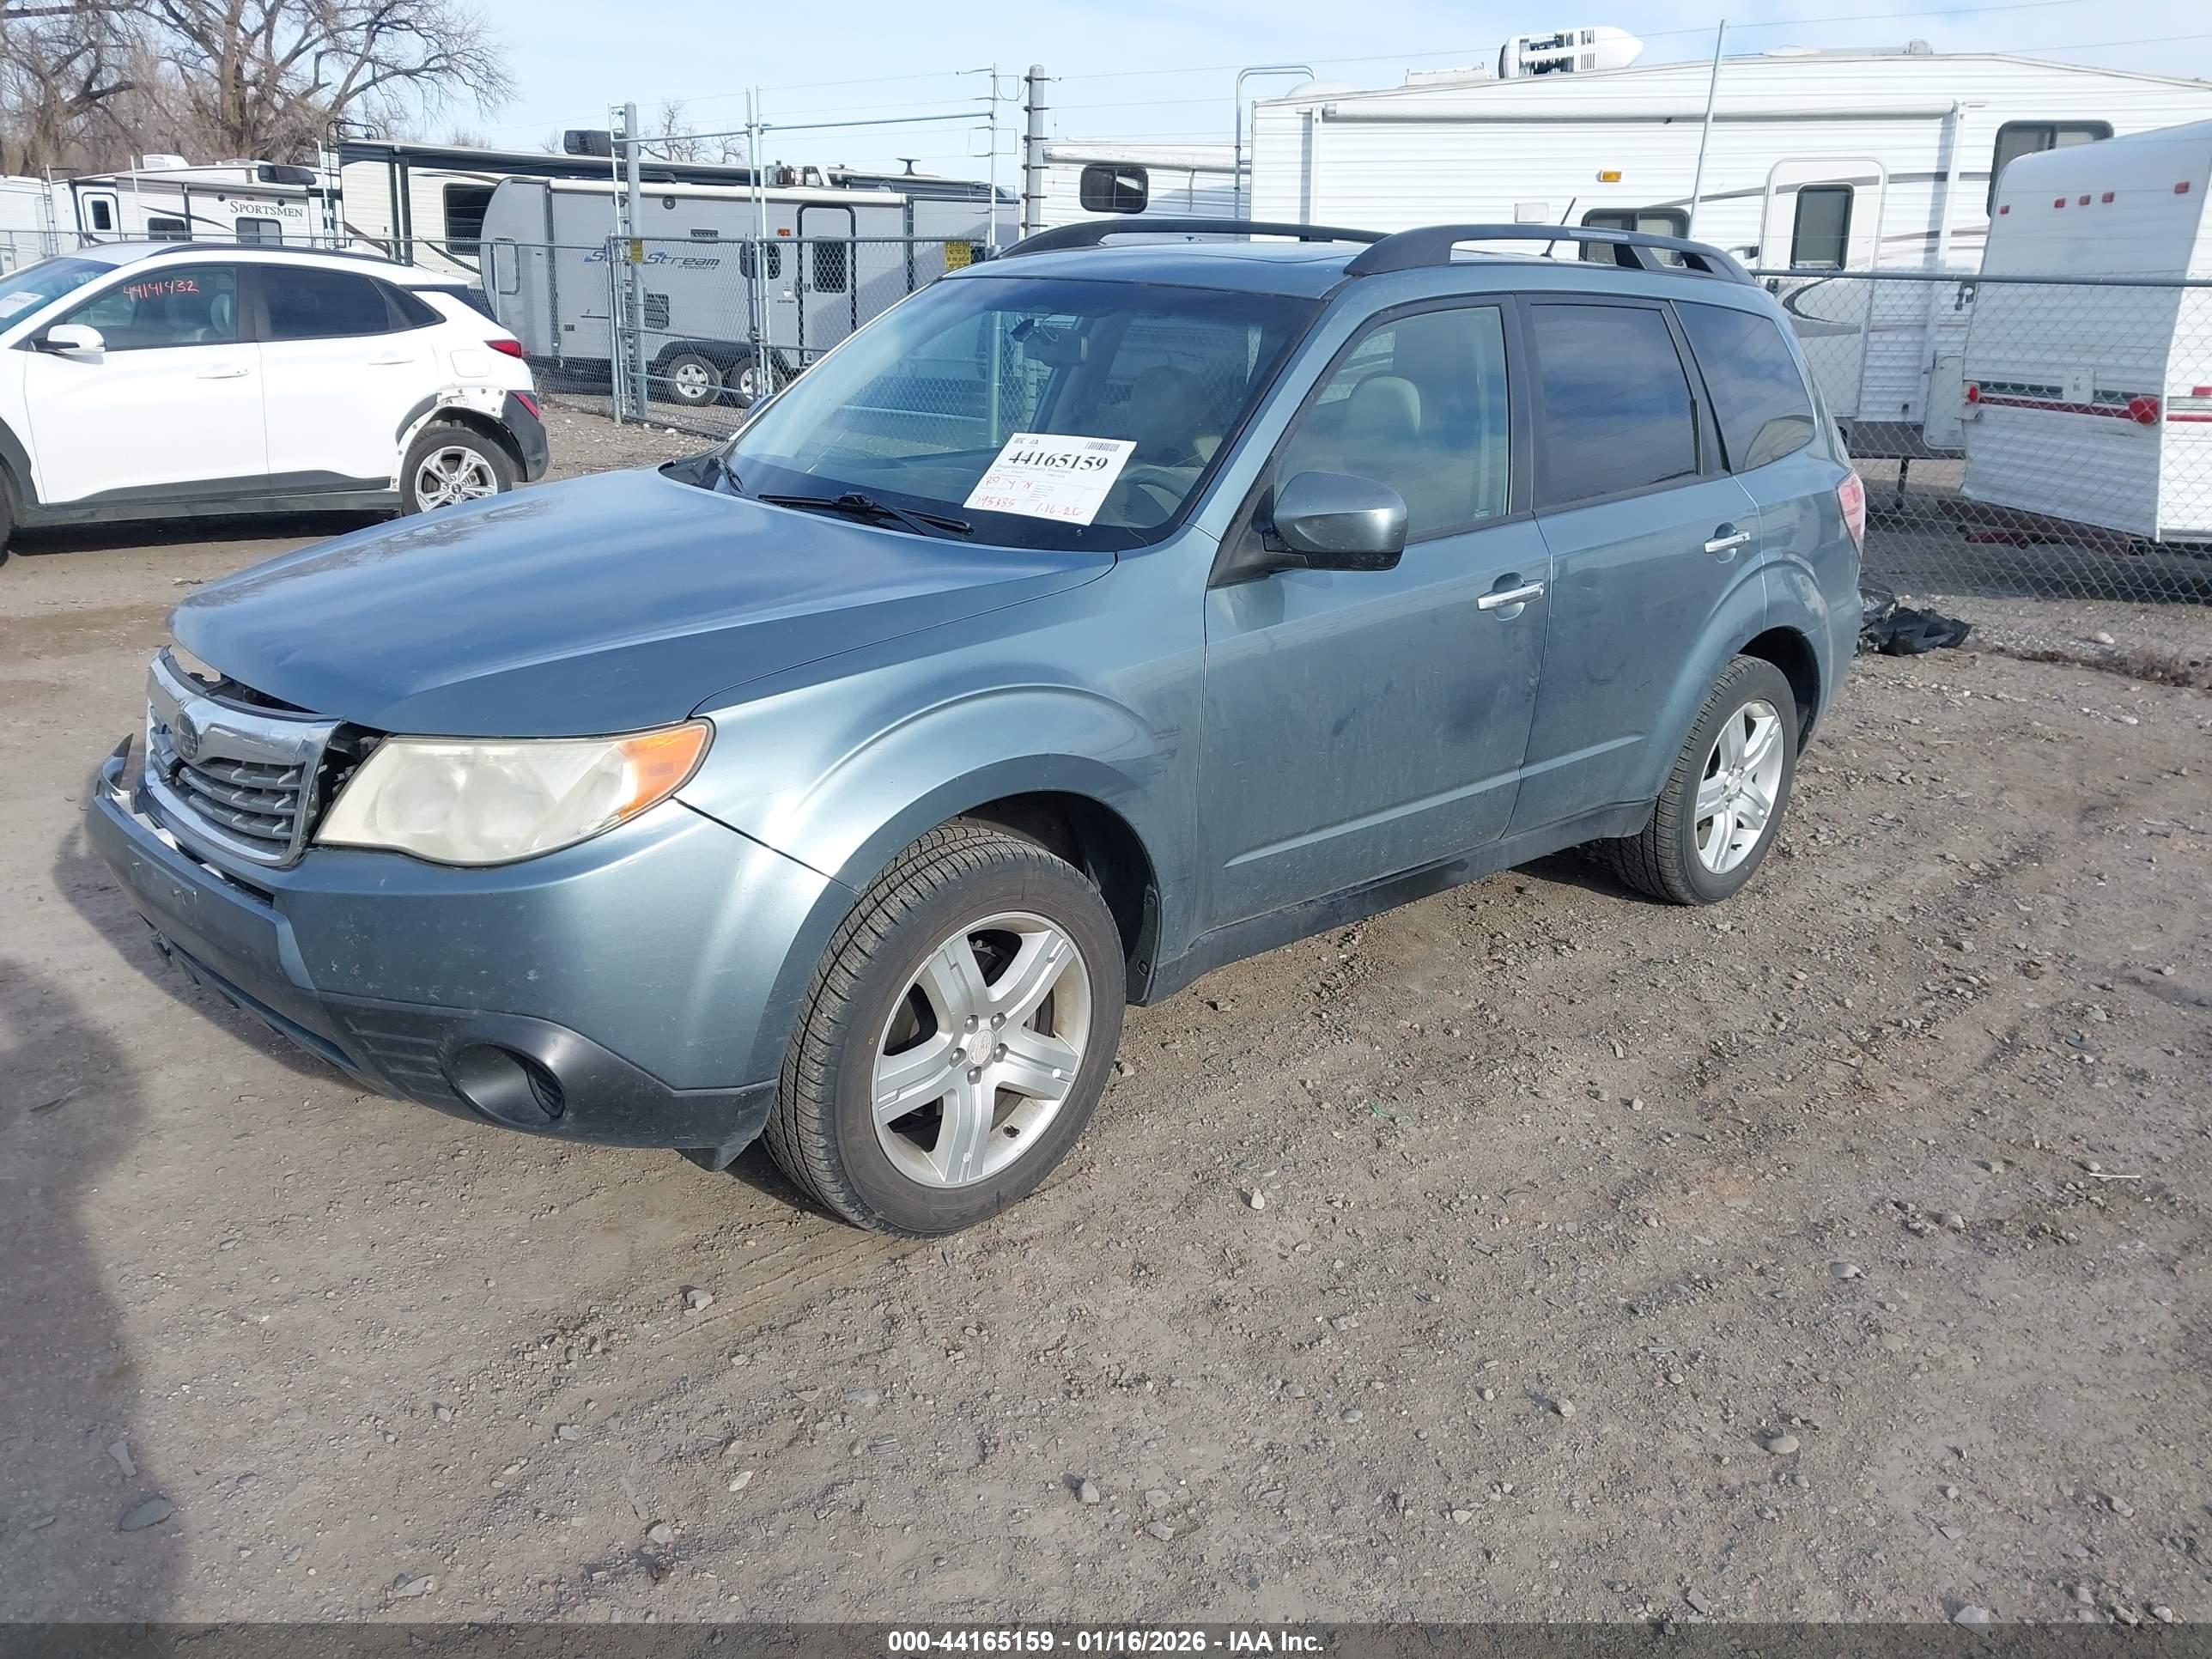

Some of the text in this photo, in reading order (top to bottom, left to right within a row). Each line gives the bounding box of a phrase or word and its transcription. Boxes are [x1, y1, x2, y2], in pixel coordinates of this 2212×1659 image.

[229, 200, 303, 218] SPORTSMEN
[643, 252, 720, 266] Stream
[123, 280, 200, 302] 44141432
[1008, 449, 1109, 472] 44165159
